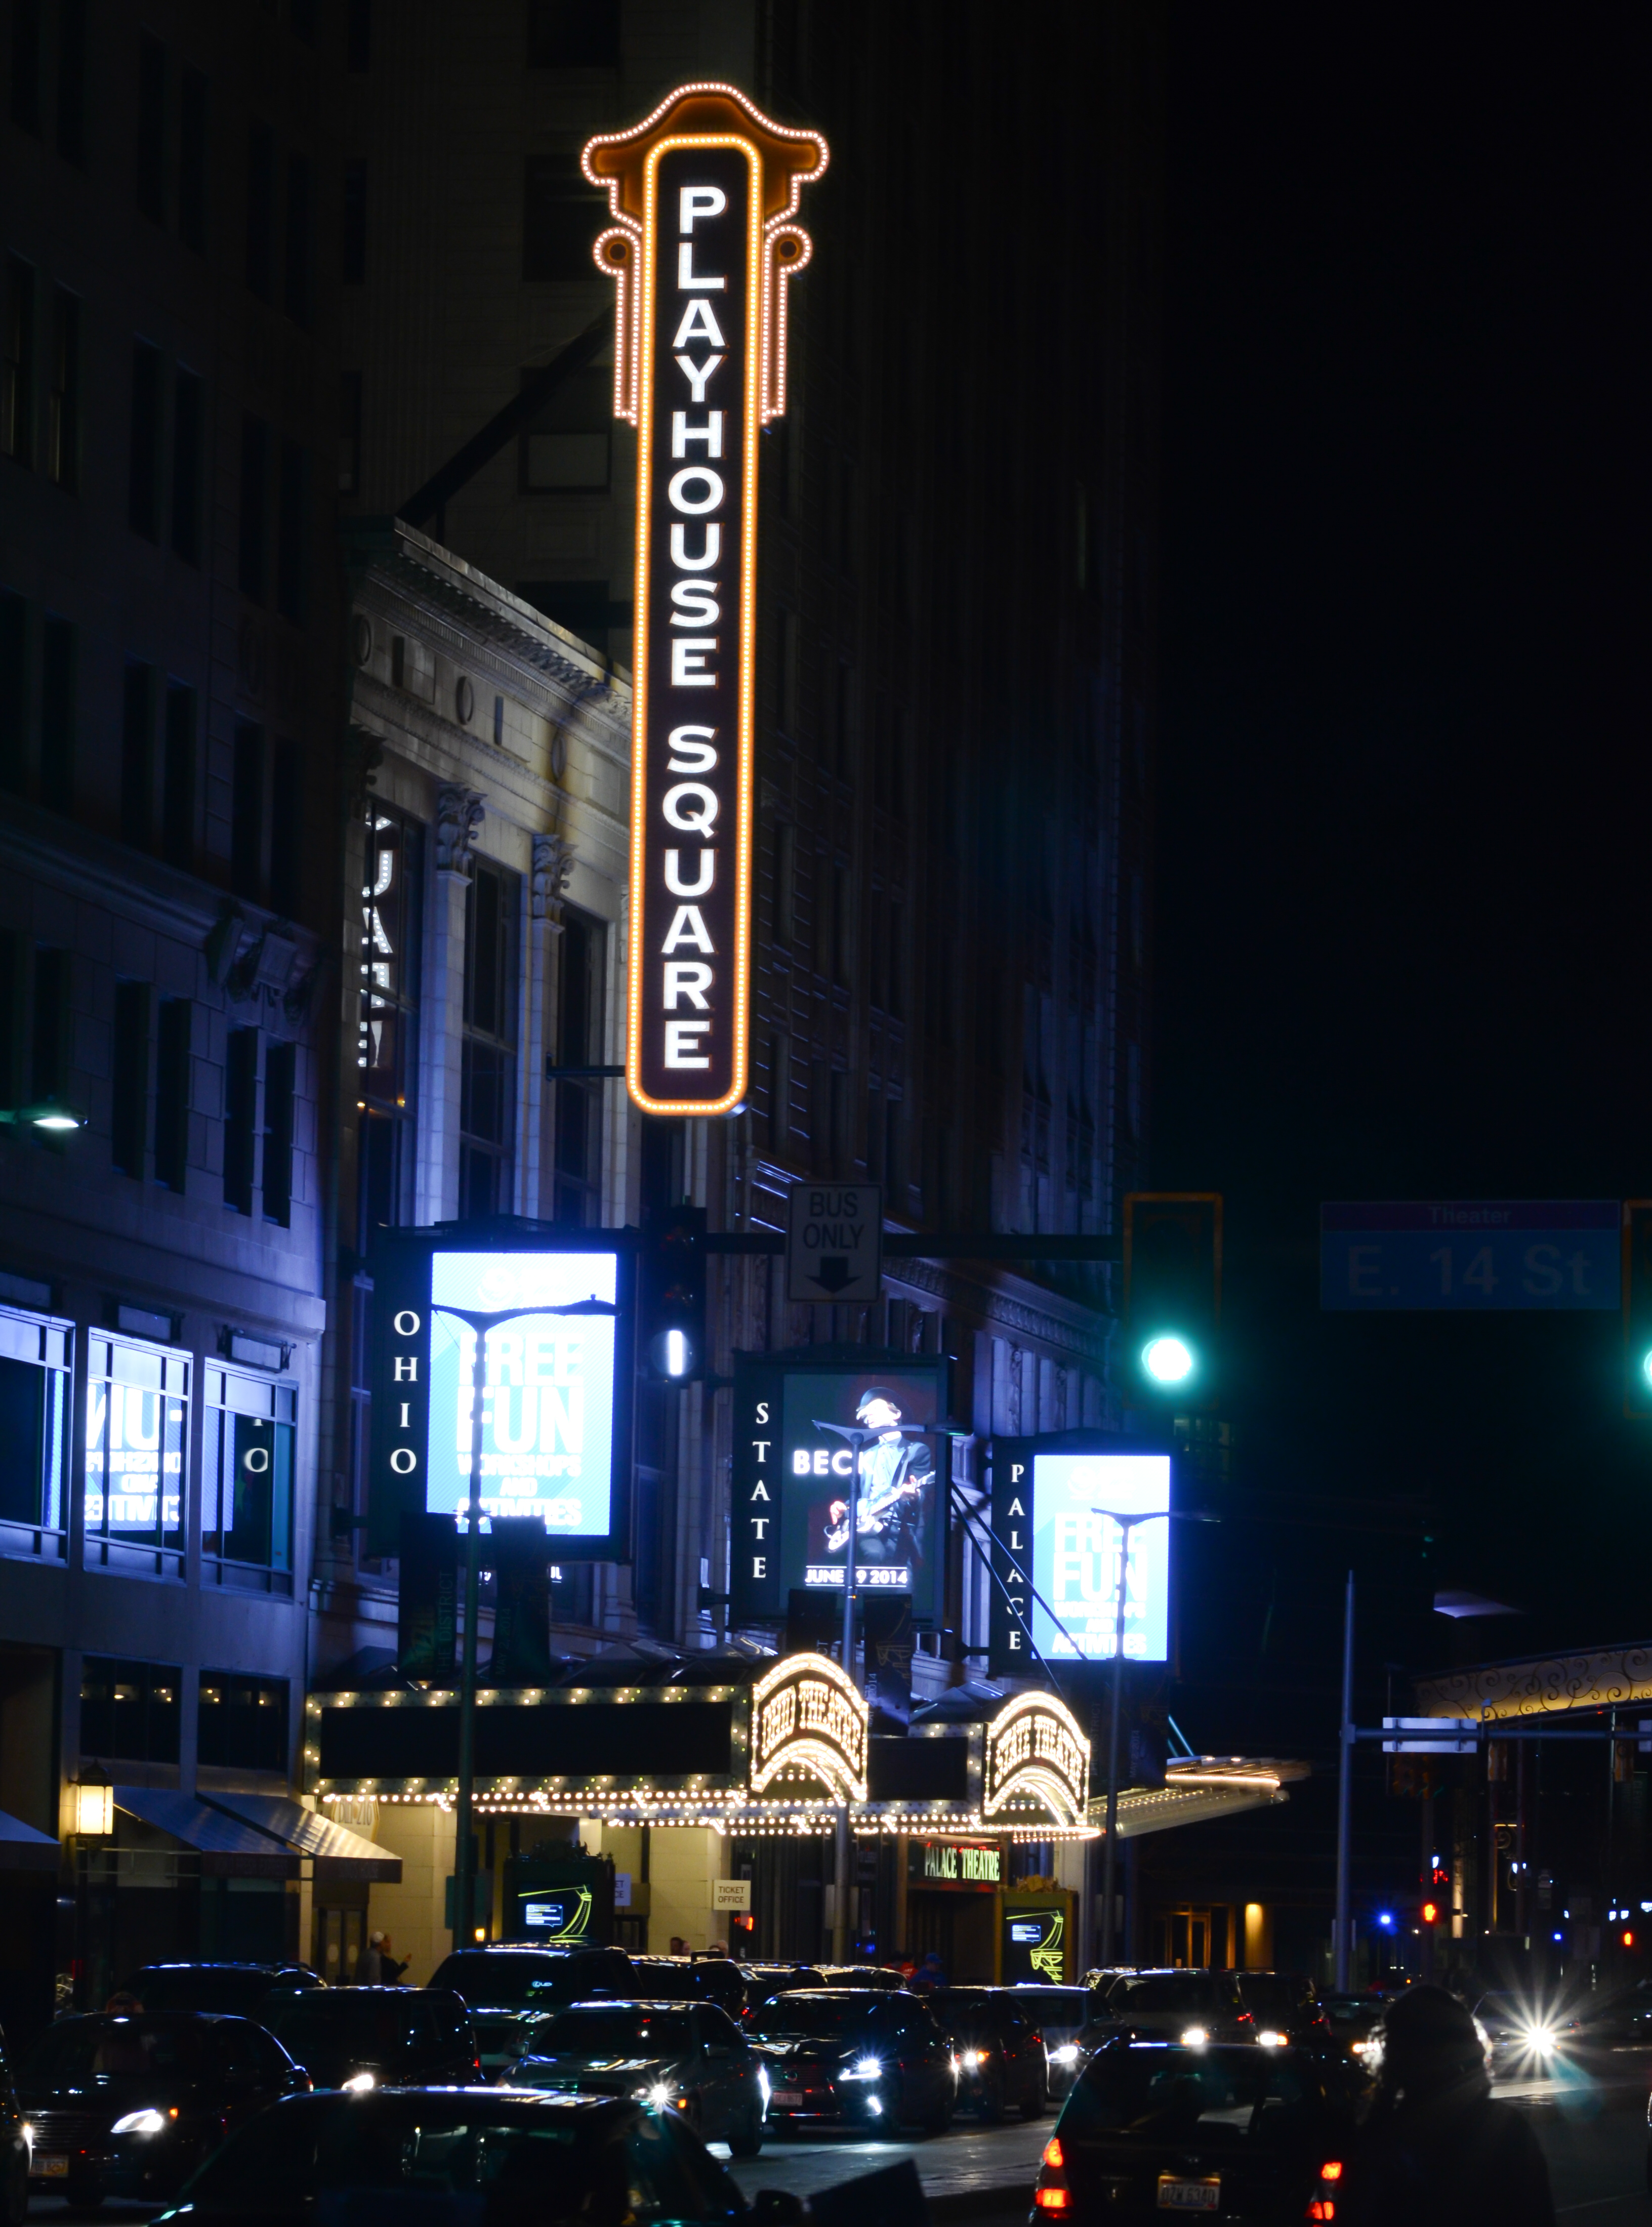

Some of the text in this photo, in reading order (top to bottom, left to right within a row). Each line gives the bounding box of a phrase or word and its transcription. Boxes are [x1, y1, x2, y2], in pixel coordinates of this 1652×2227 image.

[662, 187, 725, 1069] PLAYHOUSE SQUARE
[811, 1192, 857, 1217] BUS
[1428, 1205, 1511, 1225] Theater
[803, 1223, 864, 1249] ONLY
[1348, 1244, 1591, 1296] E. 14 St
[460, 1332, 584, 1386] FREE
[390, 1310, 420, 1473] OHIO
[457, 1386, 584, 1453] FUN
[793, 1451, 874, 1474] BECK
[500, 1477, 537, 1496] AND
[751, 1403, 771, 1578] STATE
[1054, 1512, 1147, 1552] FREE
[805, 1570, 844, 1584] JUNE
[870, 1570, 908, 1584] 2014
[1007, 1464, 1025, 1650] PALACE
[1053, 1552, 1147, 1601] FUN
[1054, 1601, 1146, 1618] WORKSHPS
[1085, 1618, 1114, 1633] AND
[1052, 1633, 1147, 1654] ACTIVITES
[798, 1680, 861, 1771] THEATRE
[995, 1715, 1083, 1800] STATE THEATRE
[924, 1847, 1000, 1881] PALACE THEATRE
